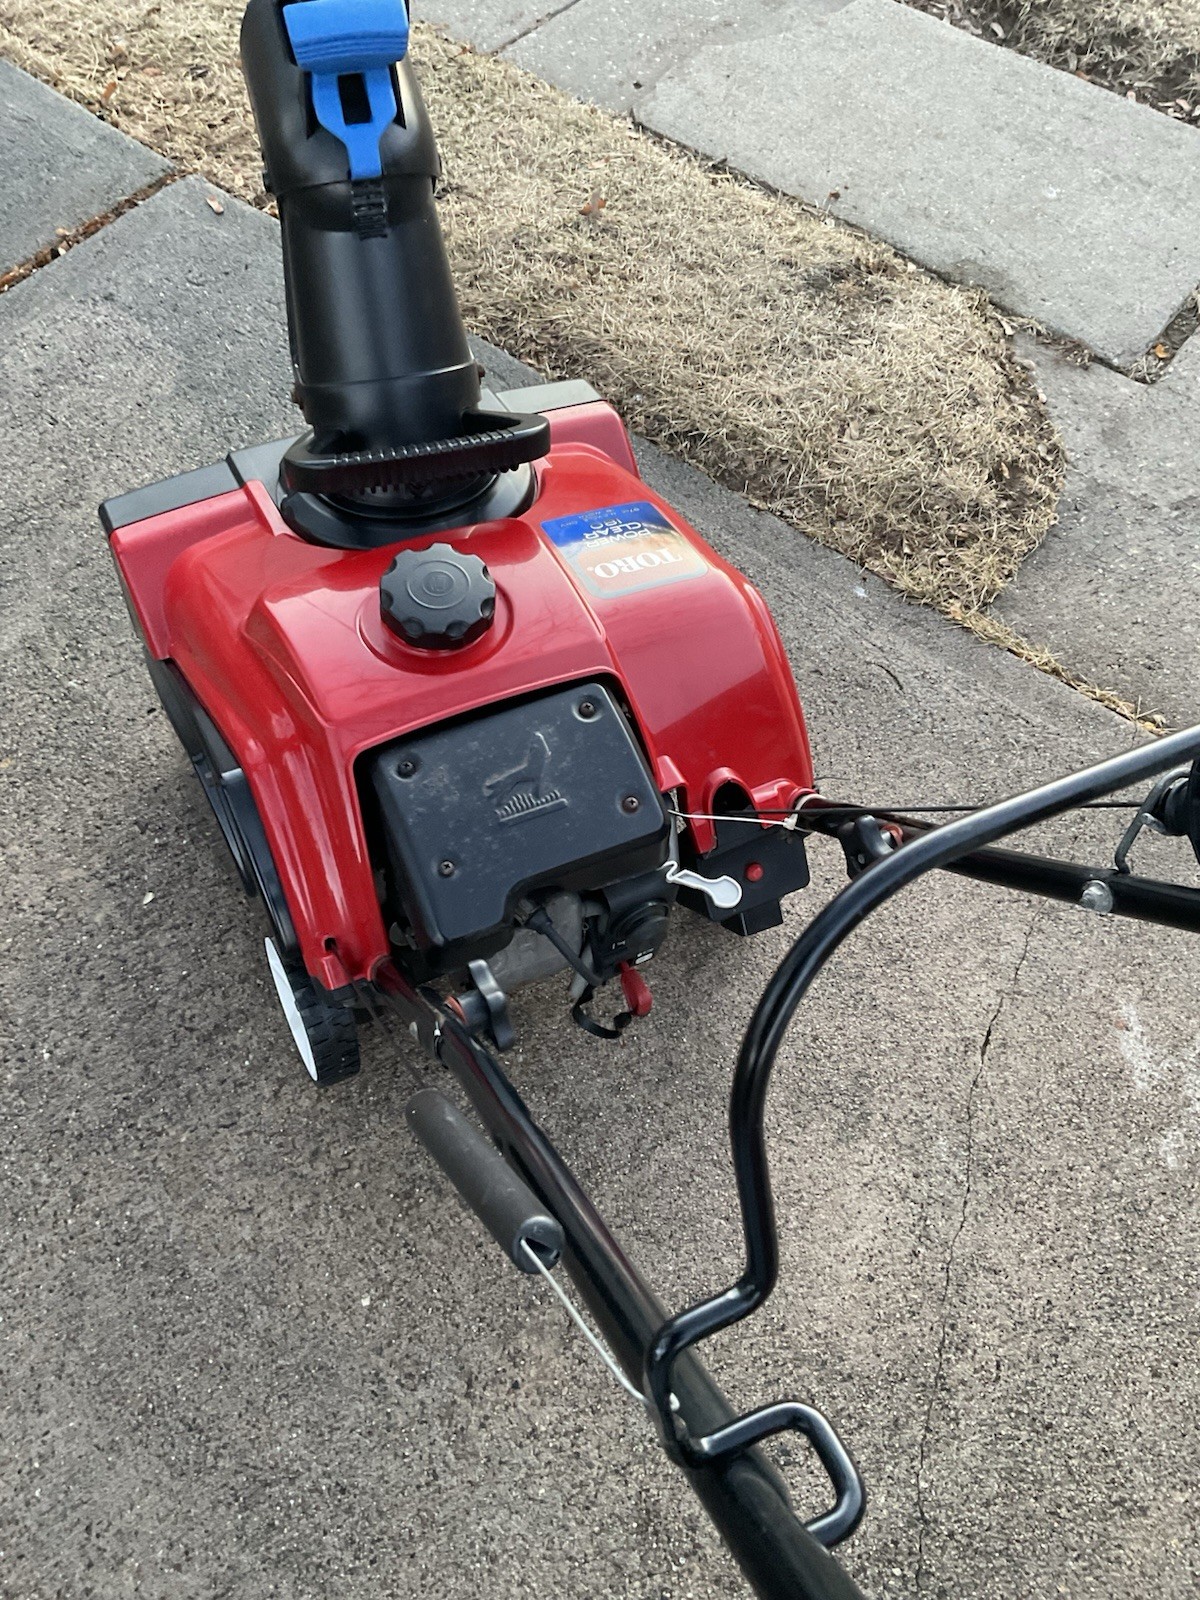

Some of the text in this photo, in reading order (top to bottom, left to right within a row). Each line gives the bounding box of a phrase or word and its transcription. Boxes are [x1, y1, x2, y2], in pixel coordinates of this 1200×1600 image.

[583, 522, 641, 539] CLEAR
[586, 528, 651, 548] POWER
[594, 548, 683, 578] TORO
